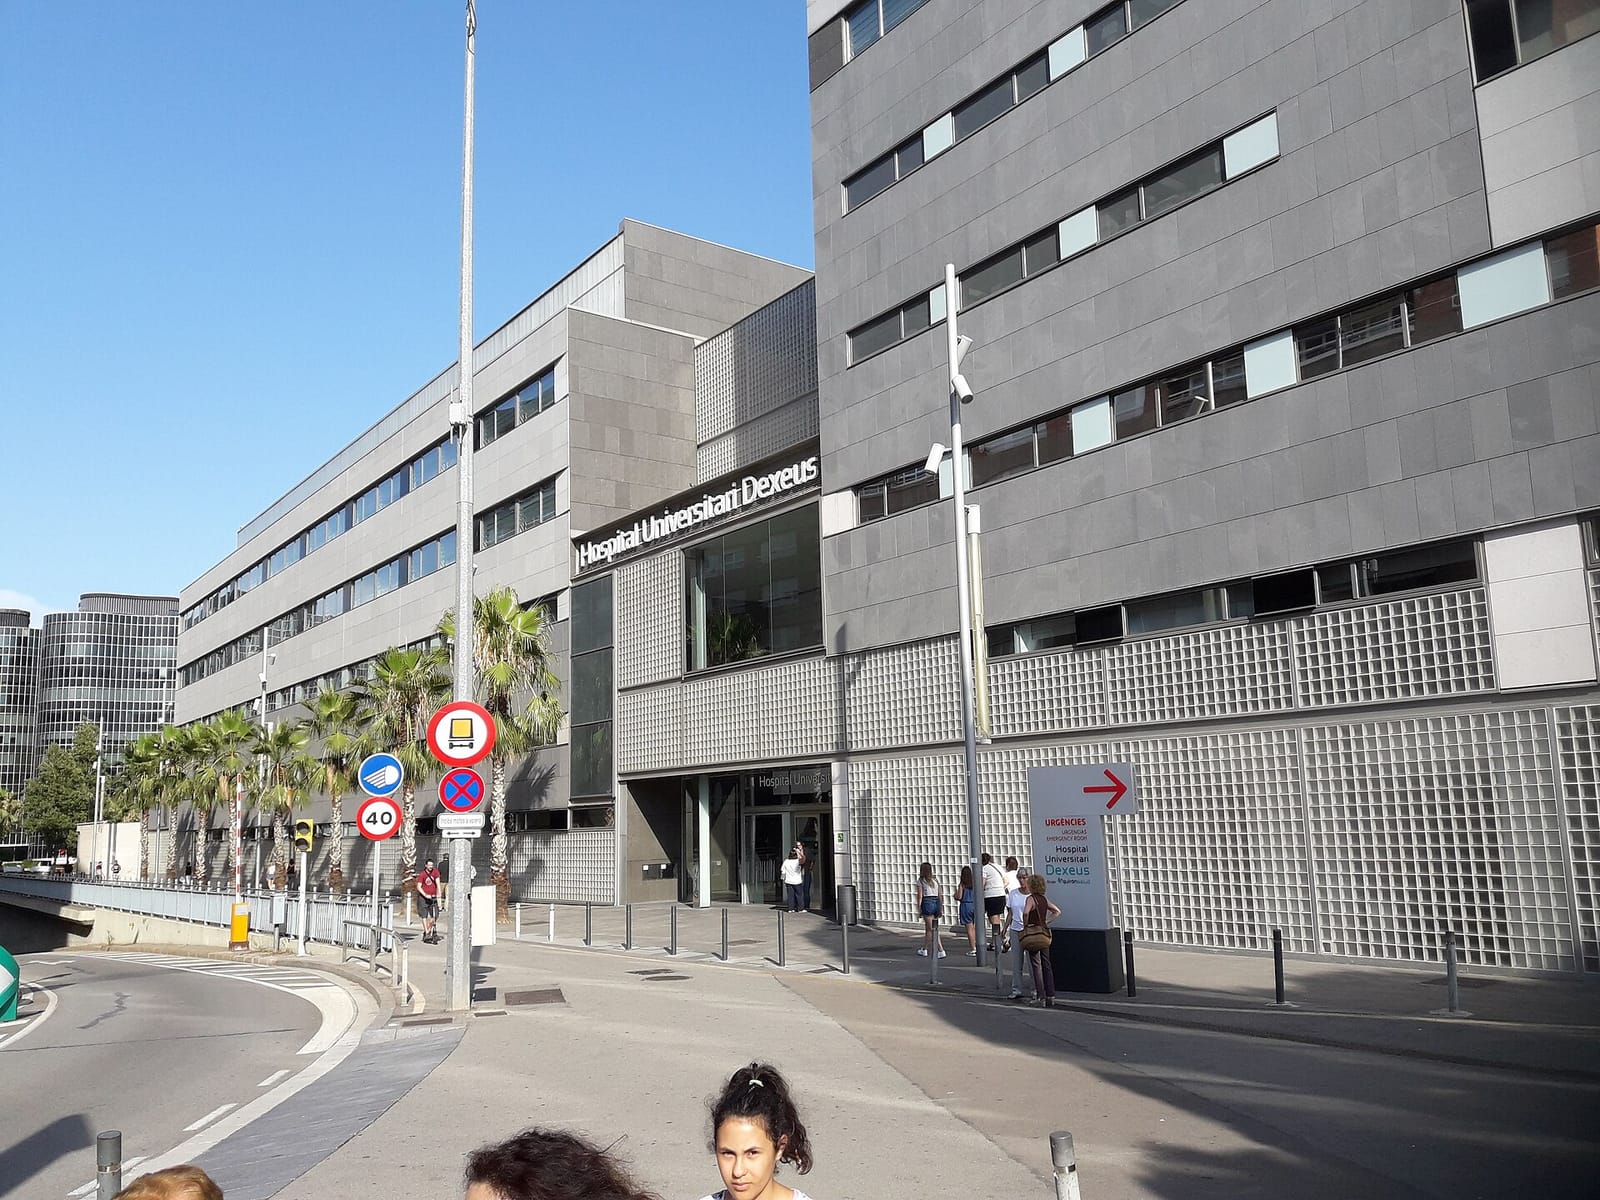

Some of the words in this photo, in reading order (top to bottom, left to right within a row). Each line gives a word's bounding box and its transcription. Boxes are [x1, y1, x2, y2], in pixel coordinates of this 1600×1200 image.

[580, 522, 642, 567] Hospital
[642, 481, 742, 543] Universitari
[741, 456, 819, 505] Dexeus
[760, 774, 792, 788] Hospital
[366, 811, 392, 825] 40
[1056, 845, 1088, 854] Hospital
[1045, 855, 1089, 864] Universitari
[1045, 864, 1090, 876] Dexeus
